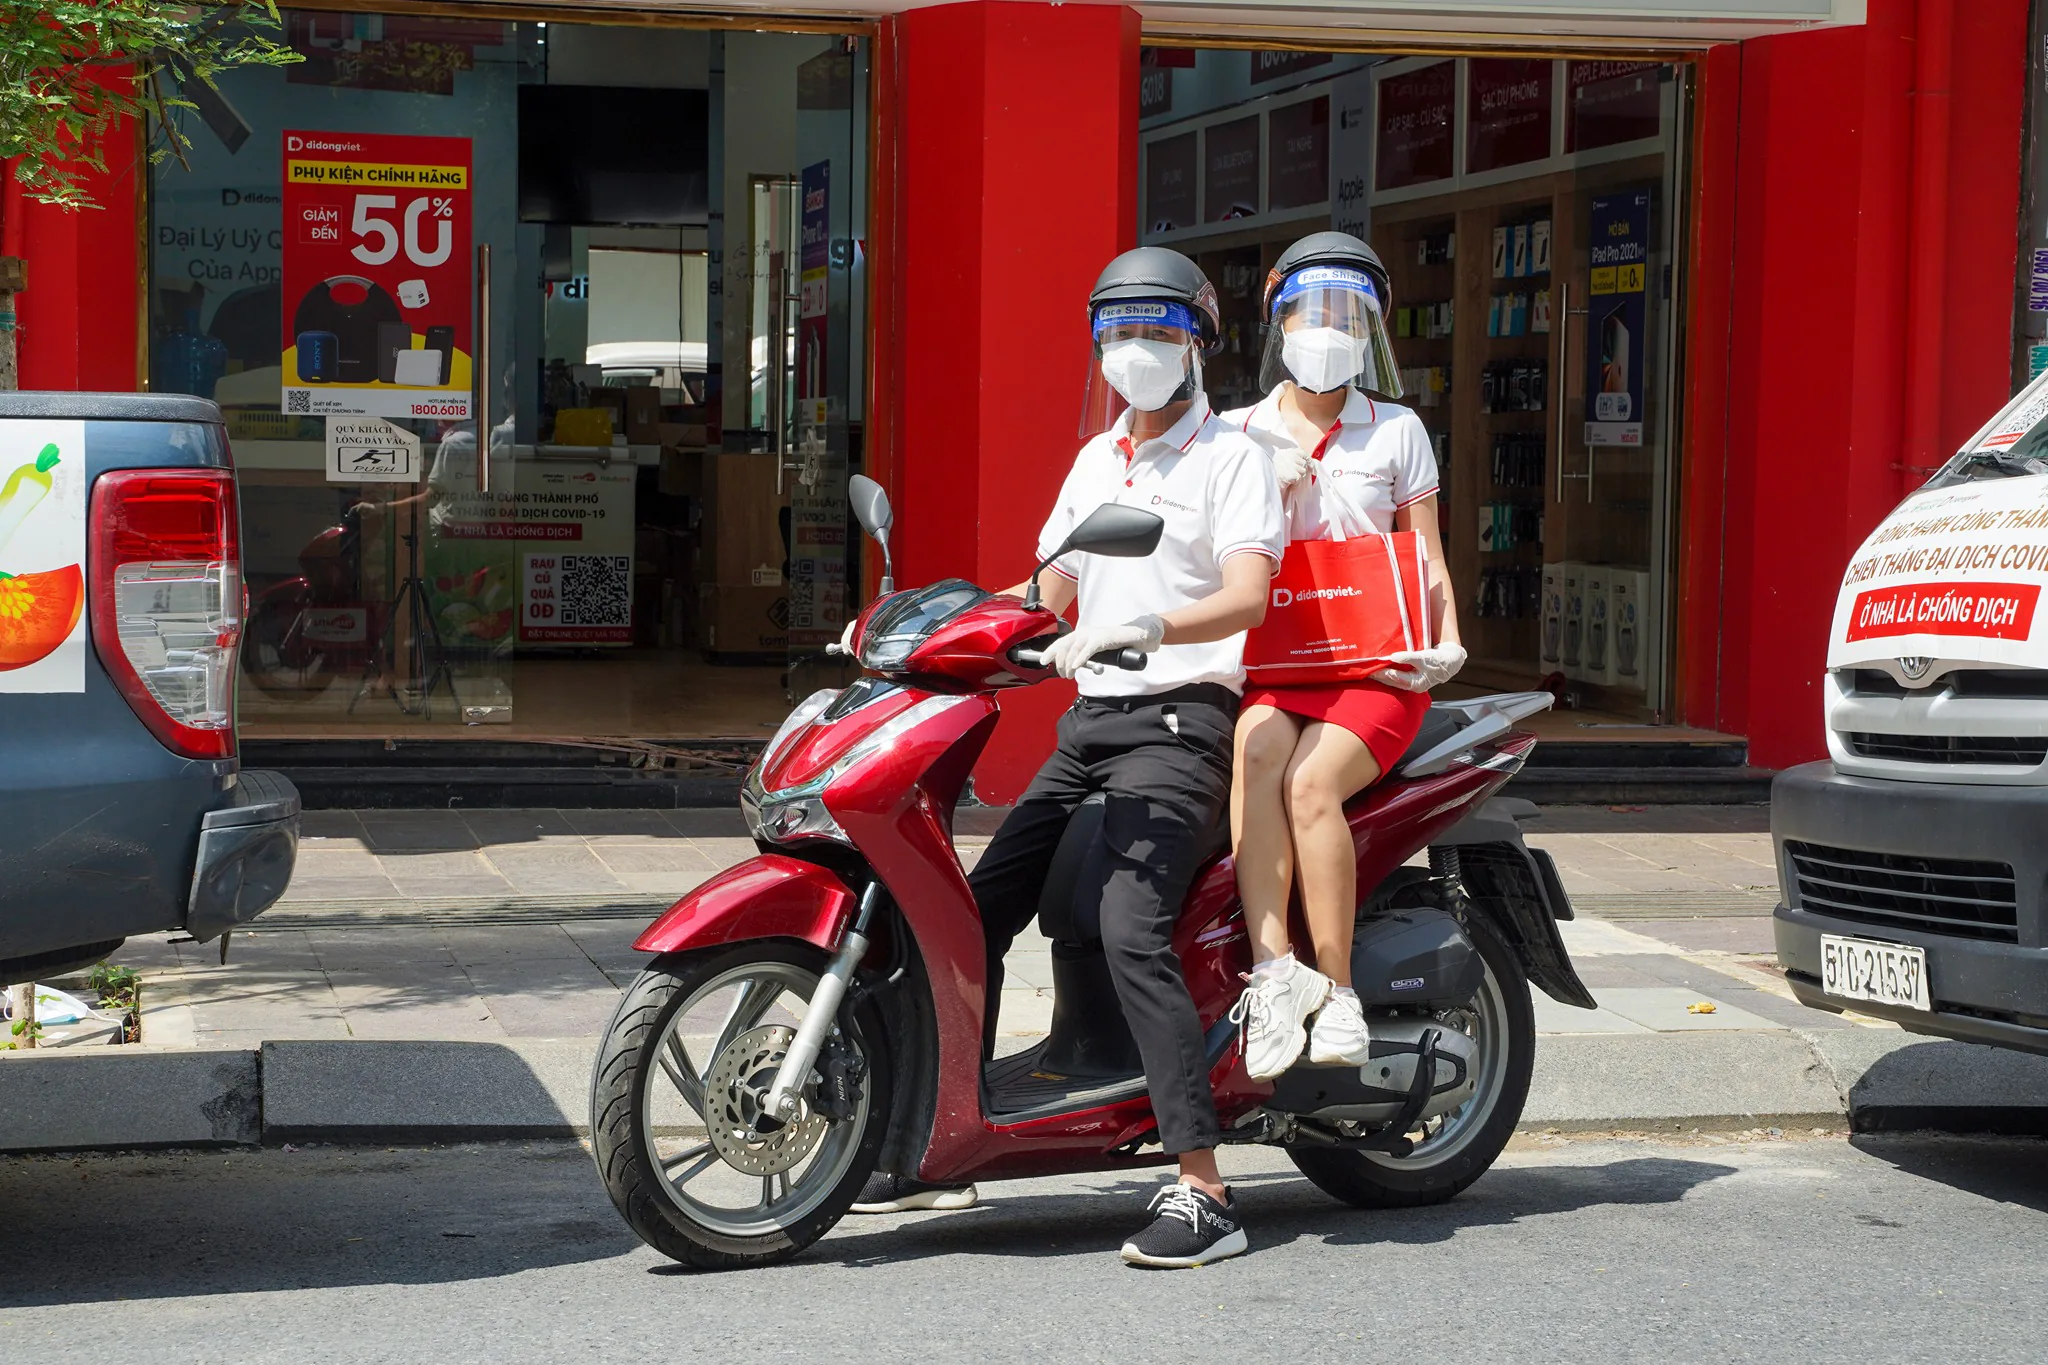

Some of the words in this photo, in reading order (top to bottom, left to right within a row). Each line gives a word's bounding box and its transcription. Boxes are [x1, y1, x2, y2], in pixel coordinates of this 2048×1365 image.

[294, 166, 325, 182] PHỤ
[329, 165, 363, 183] KIỆN
[367, 167, 415, 182] CHÍNH
[419, 169, 461, 184] HÃNG
[1339, 174, 1363, 210] Apple
[303, 207, 338, 222] GIẢM
[311, 223, 338, 240] ĐẾN
[159, 226, 195, 252] Đại
[202, 227, 226, 252] Lý
[1592, 243, 1606, 263] iPad
[1608, 243, 1619, 262] Pro
[1620, 242, 1638, 260] 2021
[188, 258, 233, 280] Của
[1303, 271, 1327, 281] Face
[1332, 271, 1365, 283] Shield
[1101, 307, 1122, 318] Face
[1125, 305, 1162, 315] Shield
[313, 340, 321, 370] SONY
[411, 404, 467, 416] 1800.6018
[358, 424, 393, 434] KHÁCH
[335, 435, 362, 444] LÒNG
[354, 465, 396, 473] PUSH
[497, 490, 529, 503] CÙNG
[532, 490, 572, 504] THÀNH
[575, 490, 599, 504] PHỐ
[499, 507, 519, 519] ĐẠI
[522, 508, 550, 520] DỊCH
[552, 508, 606, 519] COVID-19
[464, 523, 487, 536] NHÀ
[490, 523, 504, 536] LÀ
[506, 523, 545, 537] CHỐNG
[547, 527, 573, 538] DỊCH
[530, 559, 554, 569] RAU
[1845, 551, 1882, 587] CHIẾN
[1879, 544, 1929, 577] THẮNG
[1924, 545, 1957, 576] ĐẠI
[1954, 544, 2003, 575] DỊCH
[535, 570, 551, 583] CỦ
[530, 586, 555, 600] QUẢ
[1859, 596, 1873, 629] Ở
[1868, 593, 1899, 626] NHÀ
[1897, 592, 1917, 623] LÀ
[1917, 589, 1973, 623] CHỐNG
[1973, 597, 2020, 629] DỊCH
[544, 630, 573, 639] ONLINE
